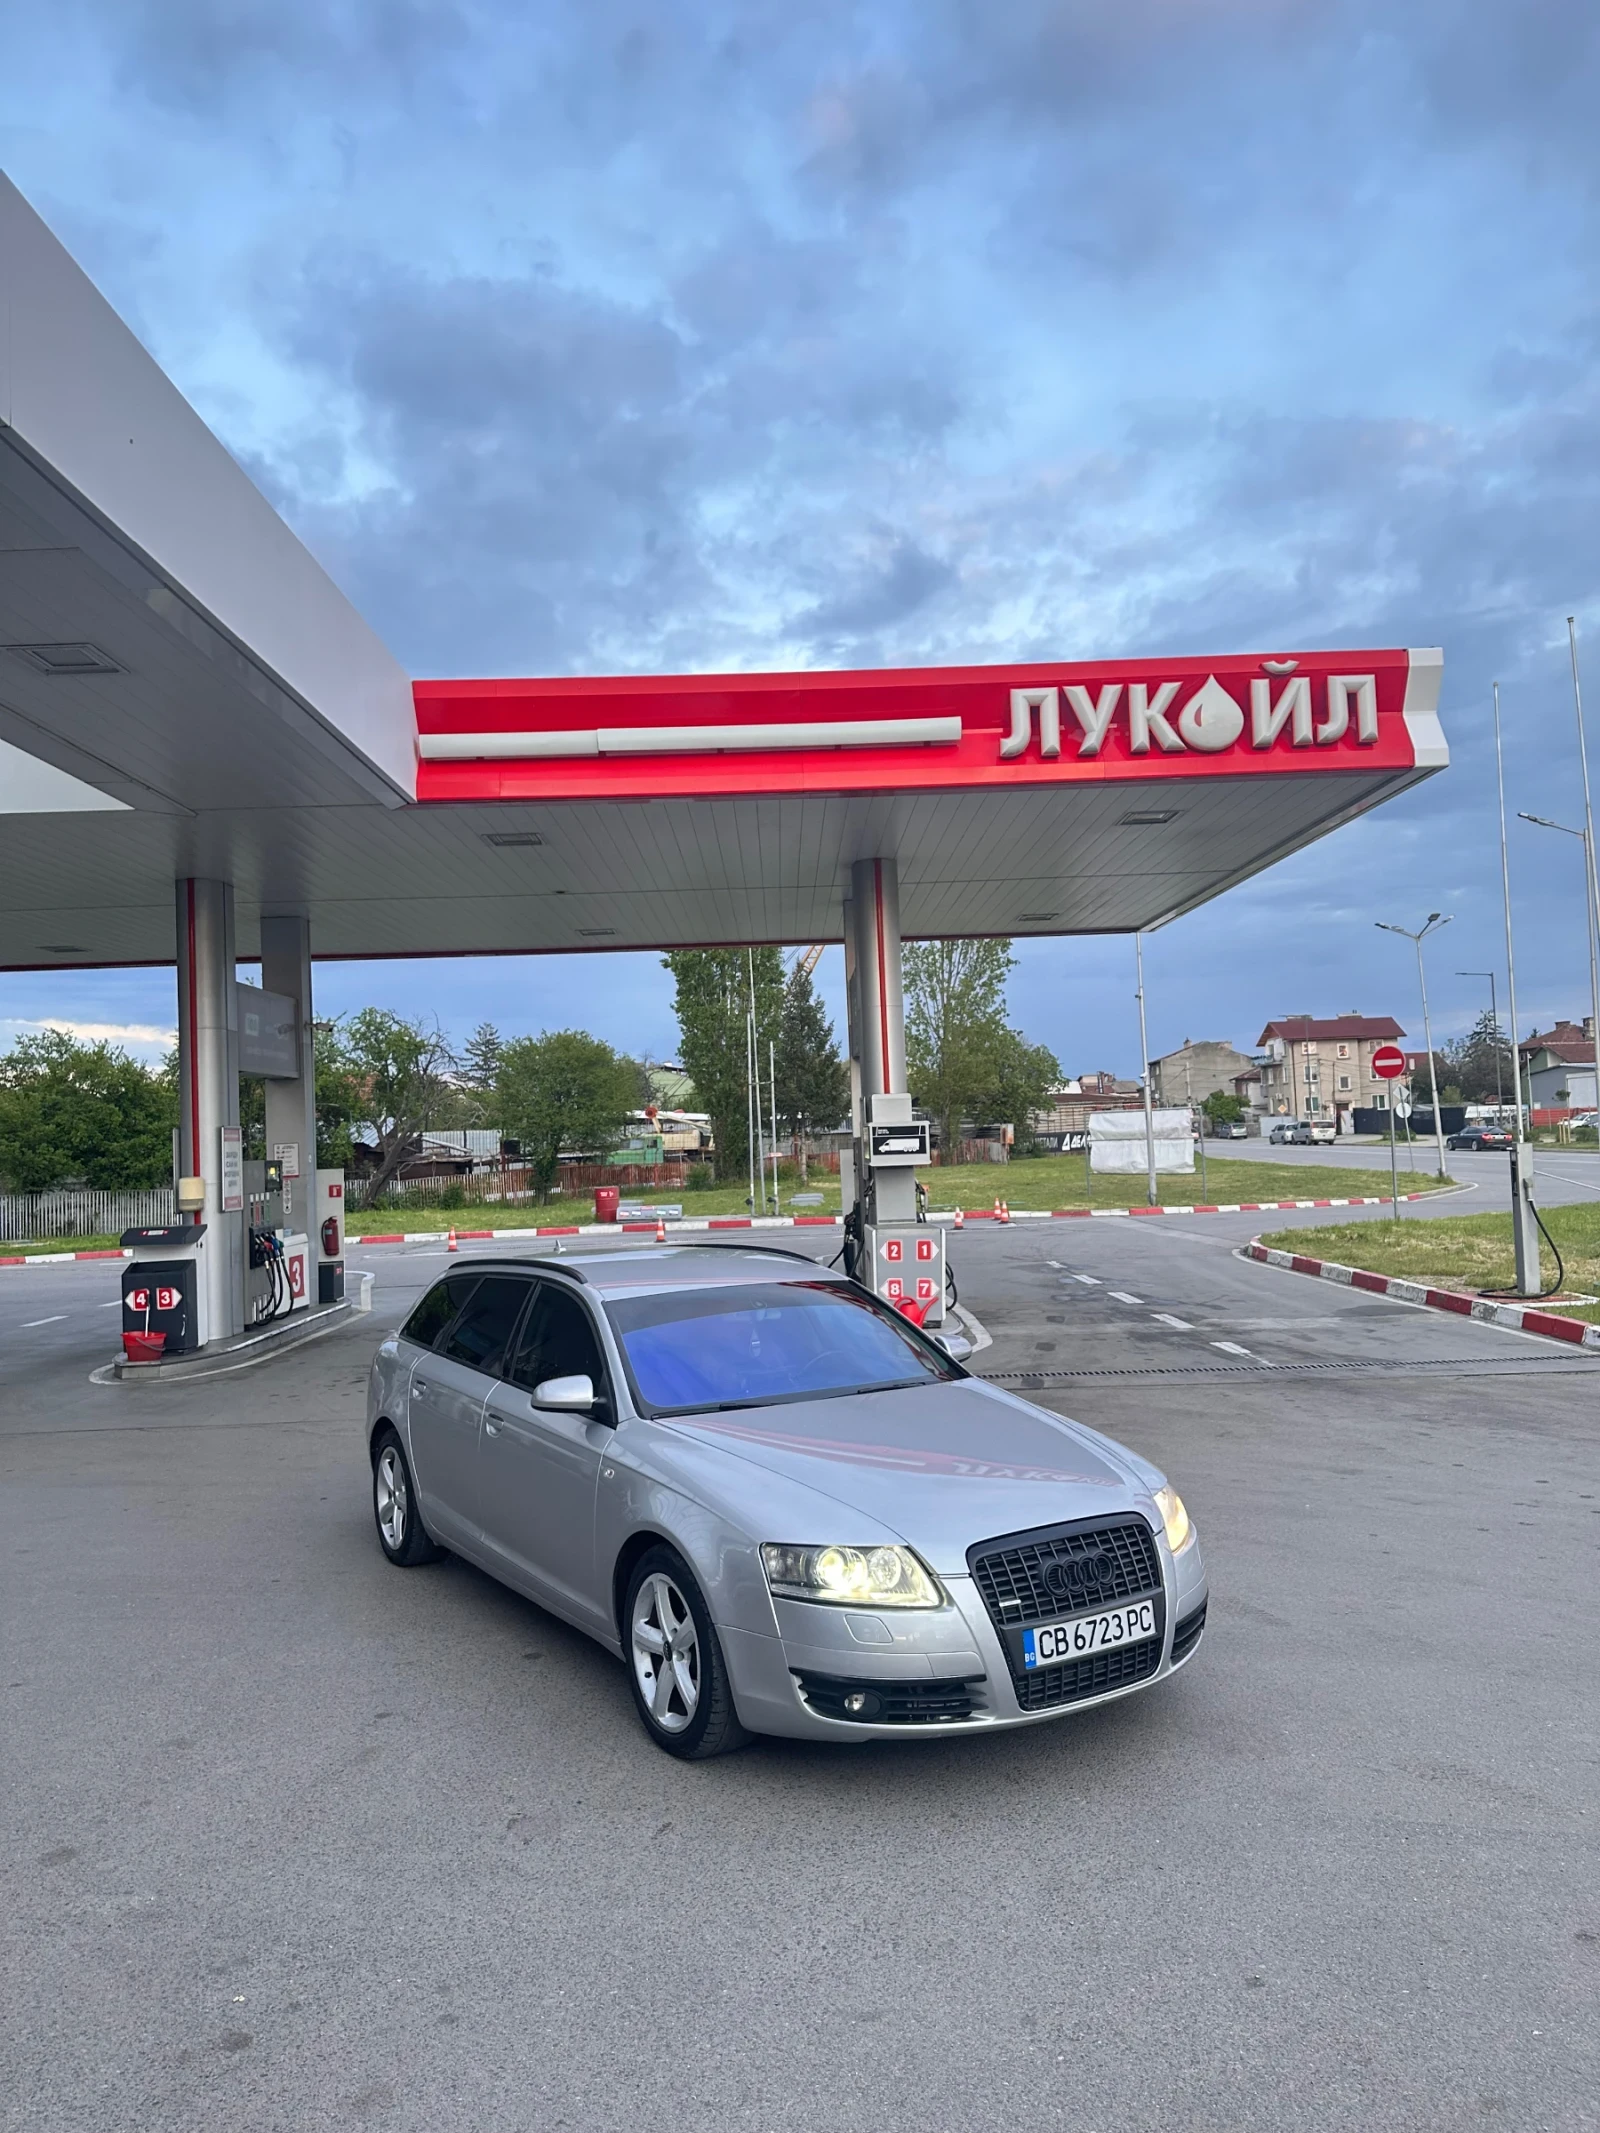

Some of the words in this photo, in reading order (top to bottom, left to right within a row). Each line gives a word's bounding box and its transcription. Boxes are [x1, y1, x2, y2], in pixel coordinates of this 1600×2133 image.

[1000, 660, 1379, 758] ЛУКОЙЛ
[890, 1244, 899, 1258] 2
[921, 1244, 928, 1257] 1
[292, 1260, 301, 1293] 3
[890, 1283, 900, 1296] 8
[919, 1283, 930, 1295] 7
[136, 1292, 147, 1306] 4
[160, 1291, 171, 1305] 3
[1039, 1626, 1069, 1659] CB
[1074, 1613, 1124, 1651] 6723
[1126, 1605, 1152, 1637] PC
[1024, 1652, 1036, 1663] BG
